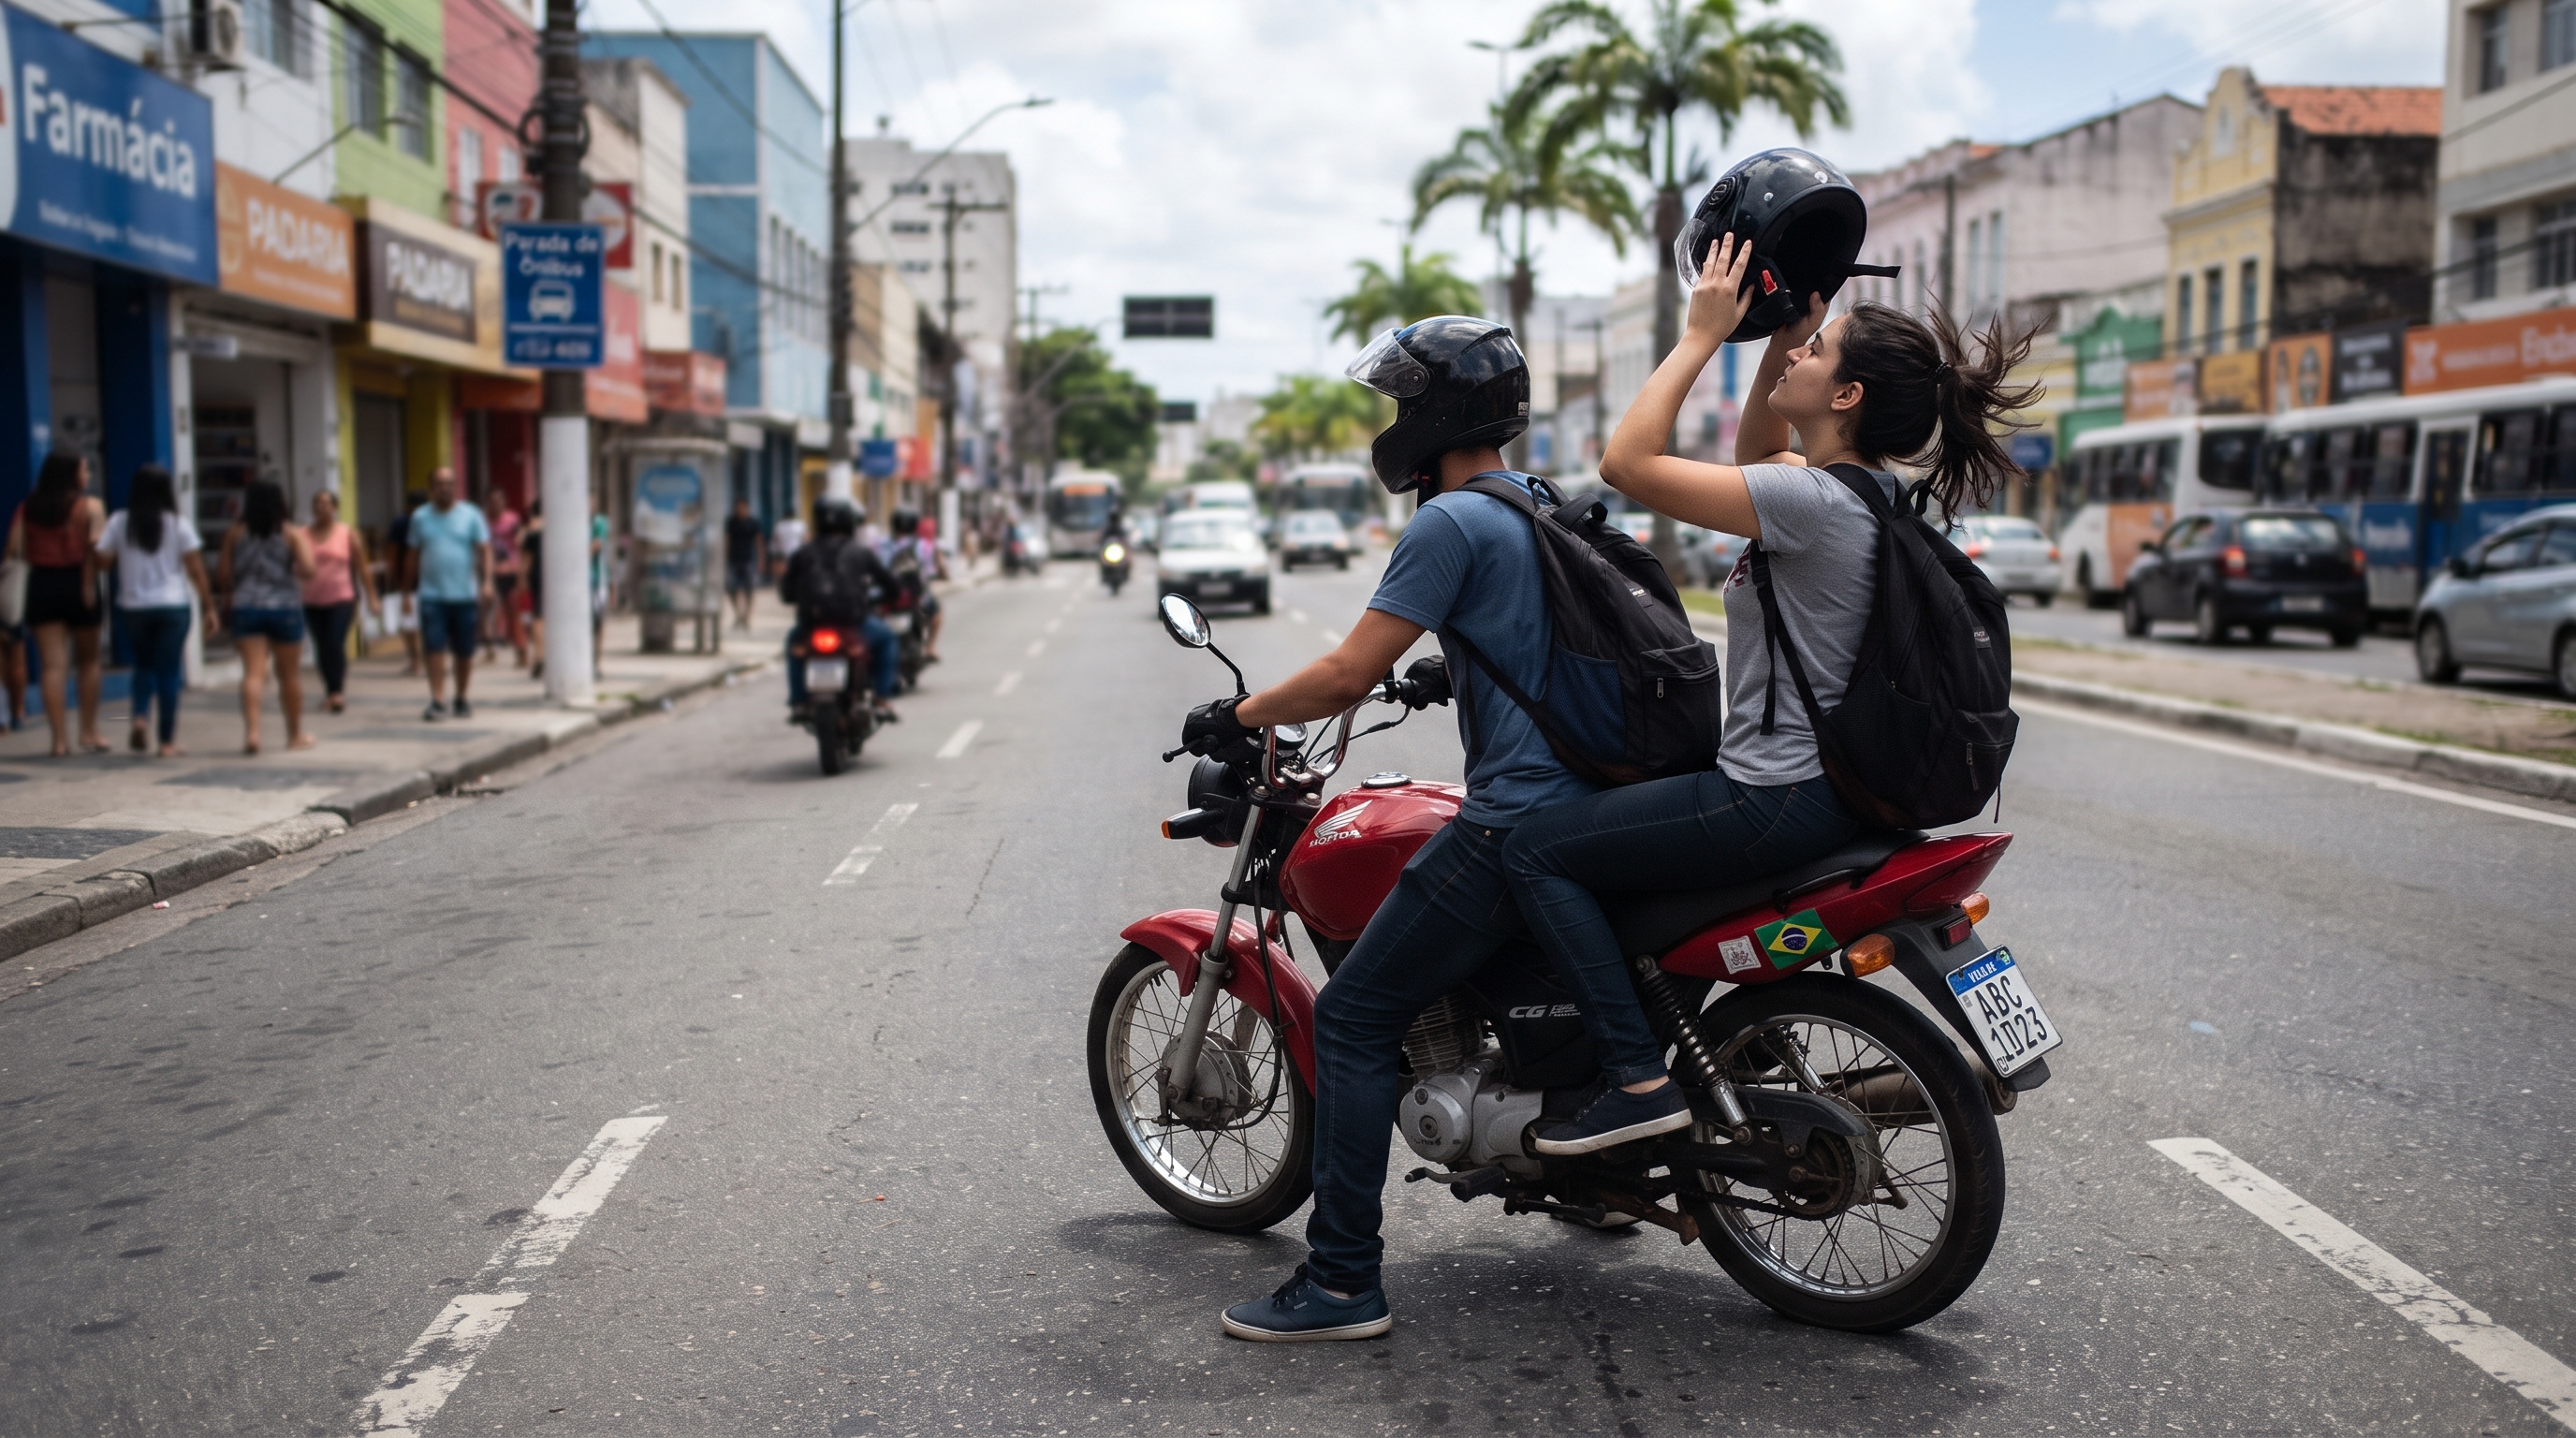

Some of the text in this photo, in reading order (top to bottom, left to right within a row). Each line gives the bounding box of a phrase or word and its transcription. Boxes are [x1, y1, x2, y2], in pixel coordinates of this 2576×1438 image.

[22, 62, 197, 199] Farmácia
[246, 198, 350, 277] PADARIA
[505, 233, 599, 254] Parada de
[385, 241, 470, 312] PADARIA
[519, 255, 585, 278] Ônibus
[1309, 829, 1362, 848] HONDA
[1508, 1005, 1548, 1019] CG
[1974, 975, 2023, 1025] ABC
[1991, 1005, 2048, 1063] 1D23
